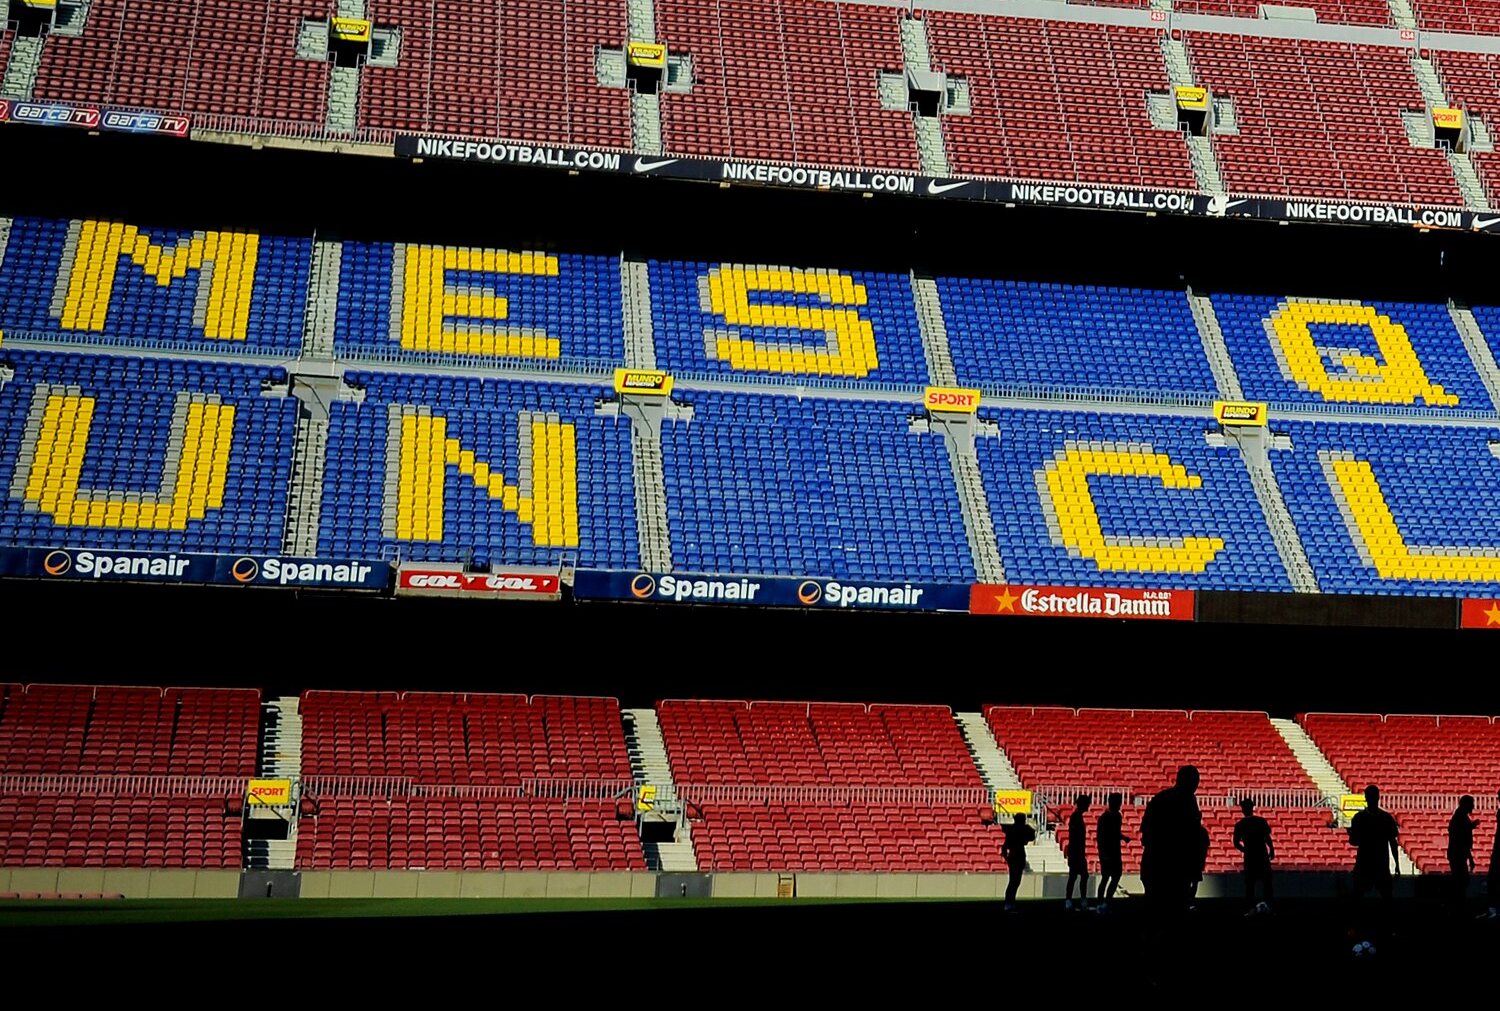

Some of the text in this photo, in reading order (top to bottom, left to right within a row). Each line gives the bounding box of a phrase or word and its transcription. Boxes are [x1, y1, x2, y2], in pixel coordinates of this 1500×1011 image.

[1151, 11, 1165, 21] 435
[1401, 30, 1415, 40] 434
[75, 111, 97, 122] TV
[164, 119, 185, 130] TV
[416, 138, 621, 170] NIKEFOOTBALL.COM
[722, 162, 915, 192] NIKEFOOTBALL.COM
[1285, 202, 1462, 227] NIKEFOOTBALL.COM
[52, 219, 879, 377] MES
[628, 374, 662, 385] MUNDO
[928, 392, 975, 407] SPORT
[1225, 405, 1257, 416] MUNDO
[13, 383, 580, 548] UN
[75, 551, 190, 578] Spanair
[261, 558, 372, 585] Spanair
[408, 574, 462, 588] GOL
[485, 576, 538, 590] GOL
[658, 575, 760, 601] Spanair
[824, 580, 924, 607] Spanair
[1020, 587, 1171, 617] Estrella Damm
[252, 786, 286, 797] SPORT
[999, 796, 1026, 807] SPORT
